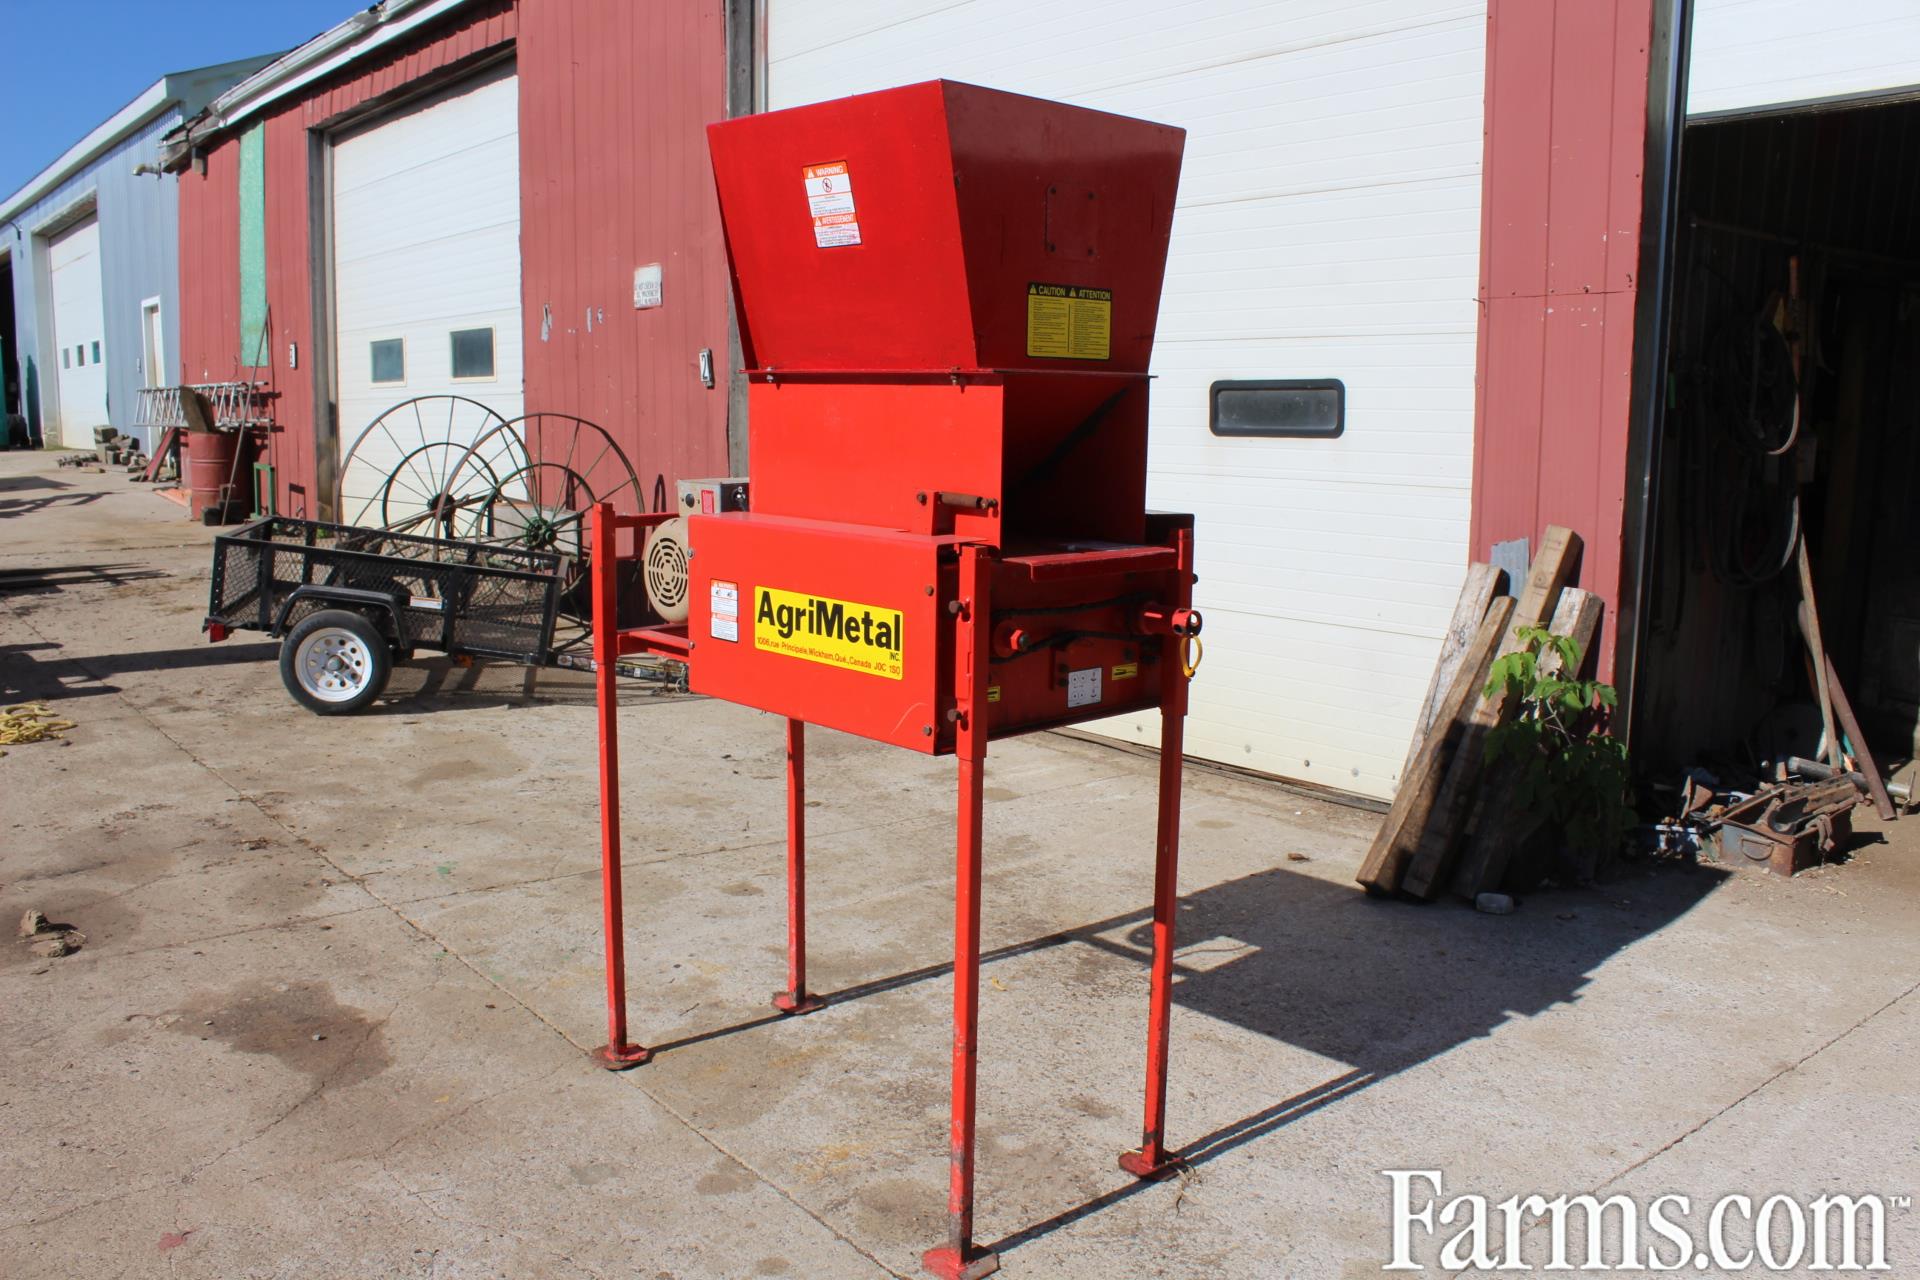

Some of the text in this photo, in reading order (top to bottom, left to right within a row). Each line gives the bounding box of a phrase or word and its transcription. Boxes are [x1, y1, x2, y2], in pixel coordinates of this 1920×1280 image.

[1038, 285, 1066, 297] CAUTION
[1078, 289, 1111, 300] ATTENTION
[701, 354, 709, 380] 2
[757, 590, 901, 652] AgriMetal
